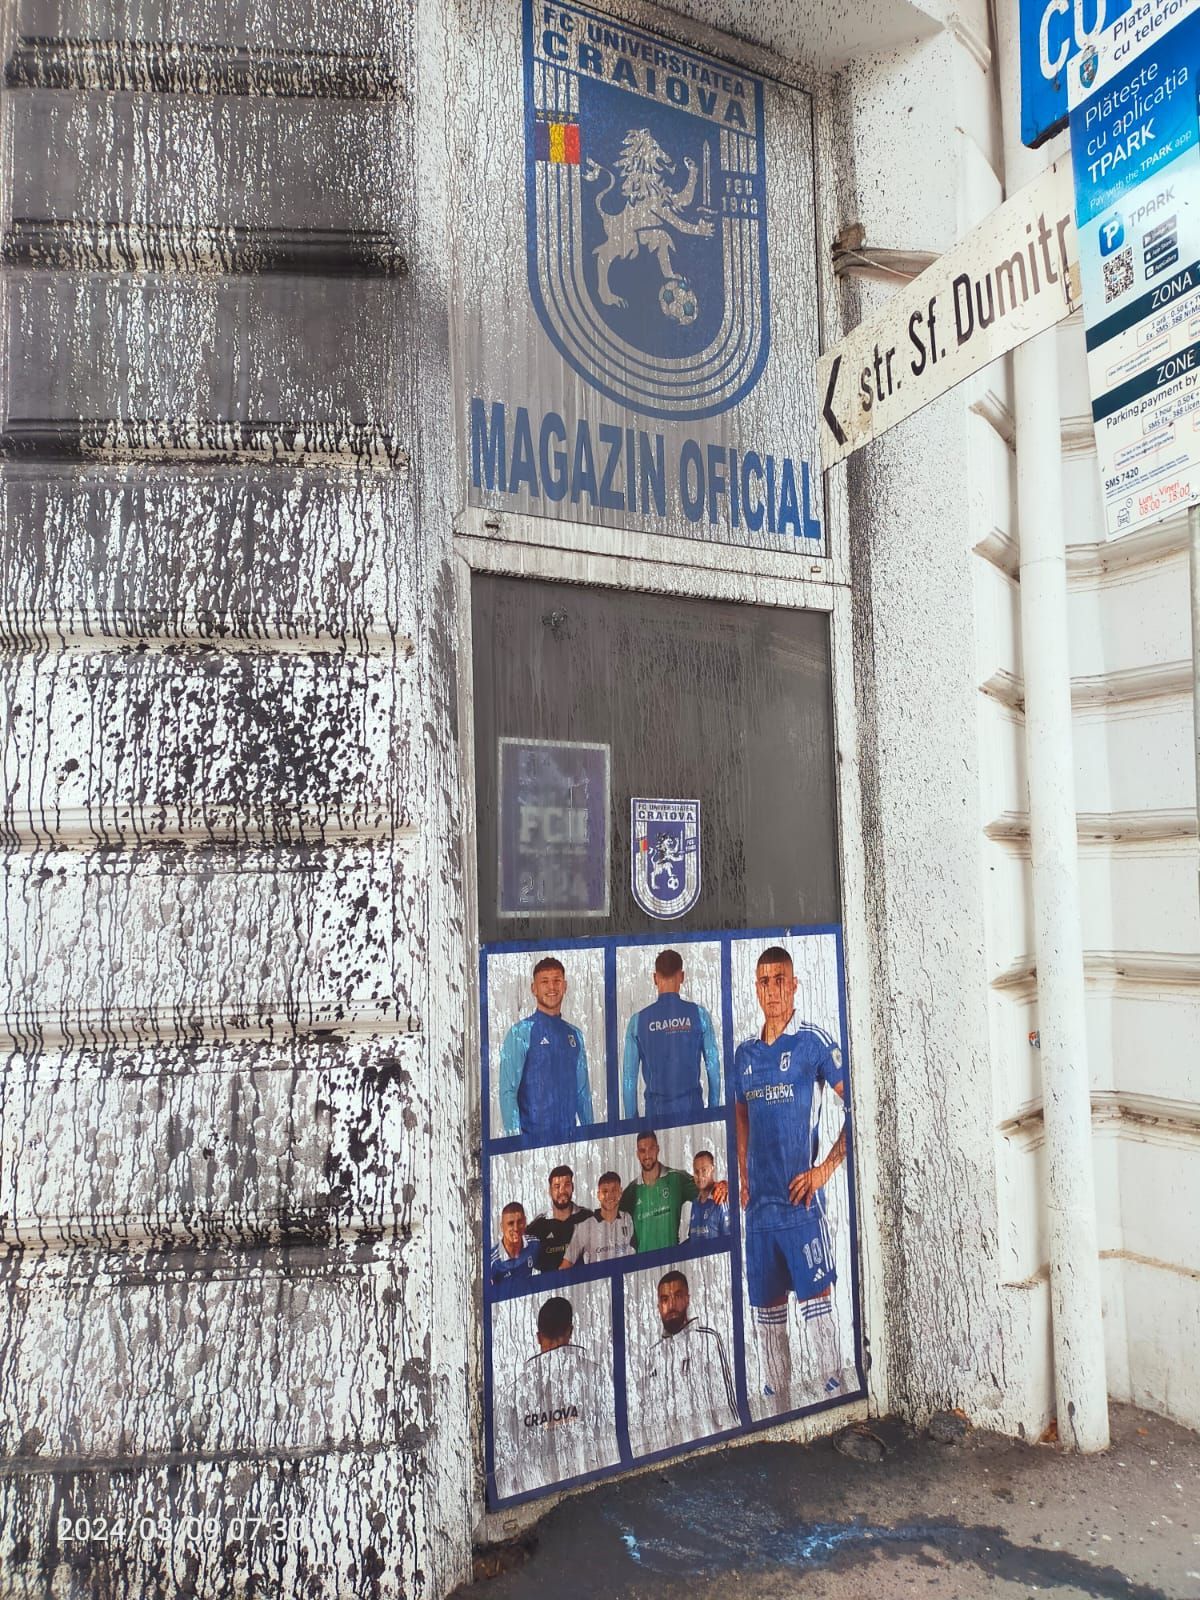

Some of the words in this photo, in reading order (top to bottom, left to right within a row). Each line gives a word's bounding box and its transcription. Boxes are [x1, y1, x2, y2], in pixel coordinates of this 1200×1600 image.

[1113, 3, 1151, 41] Plata
[543, 7, 575, 34] FC
[587, 25, 746, 98] UNIVERSITATEA
[1113, 40, 1131, 61] cu
[542, 30, 748, 129] CRAIOVA
[1085, 62, 1159, 131] Plătește
[1087, 134, 1107, 157] cu
[1112, 66, 1189, 137] aplicația
[1088, 118, 1157, 184] TPARK
[1089, 191, 1105, 210] Pay
[1106, 177, 1124, 198] with
[1125, 164, 1139, 184] the
[1140, 143, 1173, 172] TPARK
[1174, 130, 1192, 150] app
[1128, 185, 1177, 228] TPARK
[1151, 271, 1193, 309] ZONA
[860, 344, 902, 413] str.
[908, 297, 946, 377] Sf.
[1156, 349, 1196, 385] ZONE
[1106, 404, 1139, 430] Parking
[1142, 381, 1183, 411] payment
[1186, 373, 1198, 386] by
[470, 397, 666, 518] MAGAZIN
[680, 438, 822, 540] OFICIAL
[1105, 474, 1121, 491] SMS
[1121, 466, 1139, 483] 7420
[638, 810, 694, 821] CRAIOVA
[648, 1016, 692, 1032] CRAIOVA
[802, 1237, 823, 1269] 10
[523, 1405, 579, 1428] CRAIOVA
